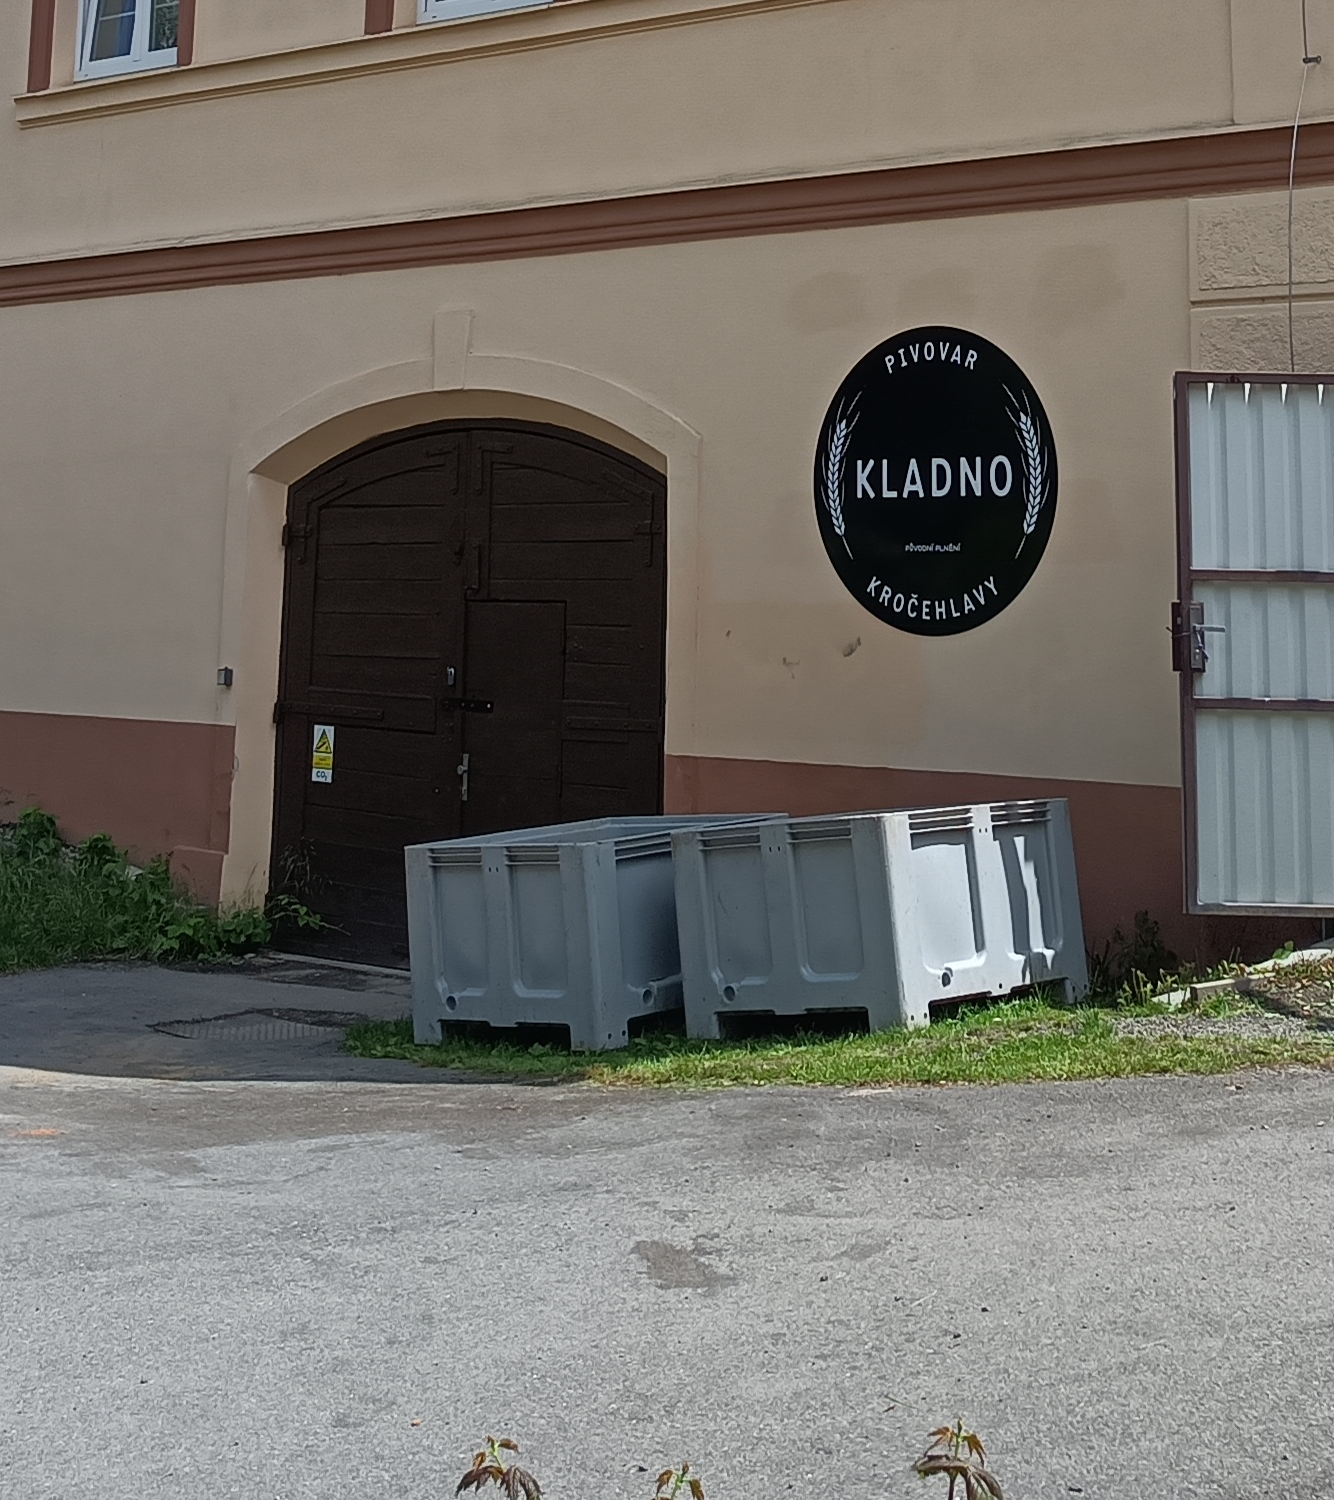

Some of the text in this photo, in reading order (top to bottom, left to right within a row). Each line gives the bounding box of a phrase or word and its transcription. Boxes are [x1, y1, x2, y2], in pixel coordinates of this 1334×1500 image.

[884, 341, 978, 374] PIVOVAR
[856, 454, 1013, 499] KLADNO
[866, 575, 998, 621] KROČEHLAVY
